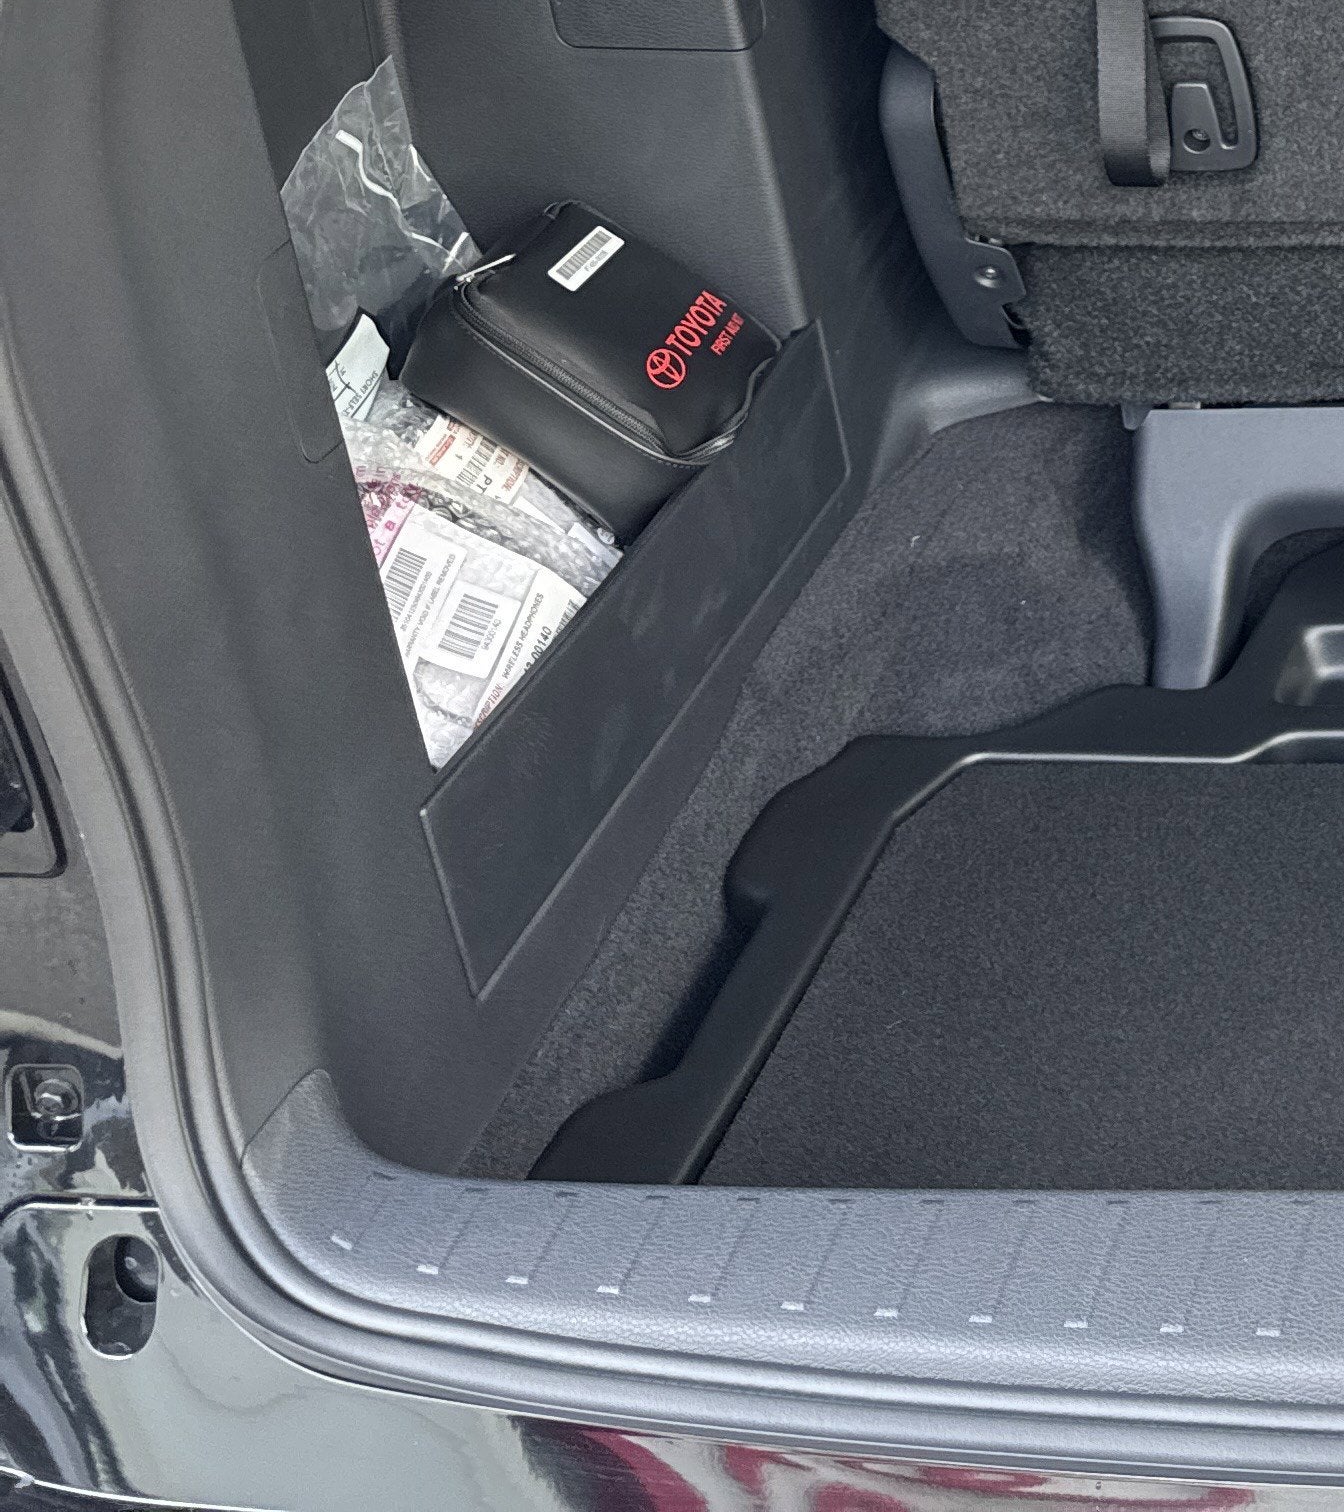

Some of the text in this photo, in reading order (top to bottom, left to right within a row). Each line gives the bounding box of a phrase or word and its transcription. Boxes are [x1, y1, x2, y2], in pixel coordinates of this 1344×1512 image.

[664, 290, 728, 357] TOYOTA
[710, 330, 734, 356] FIRST
[518, 592, 545, 641] HEADPHONES
